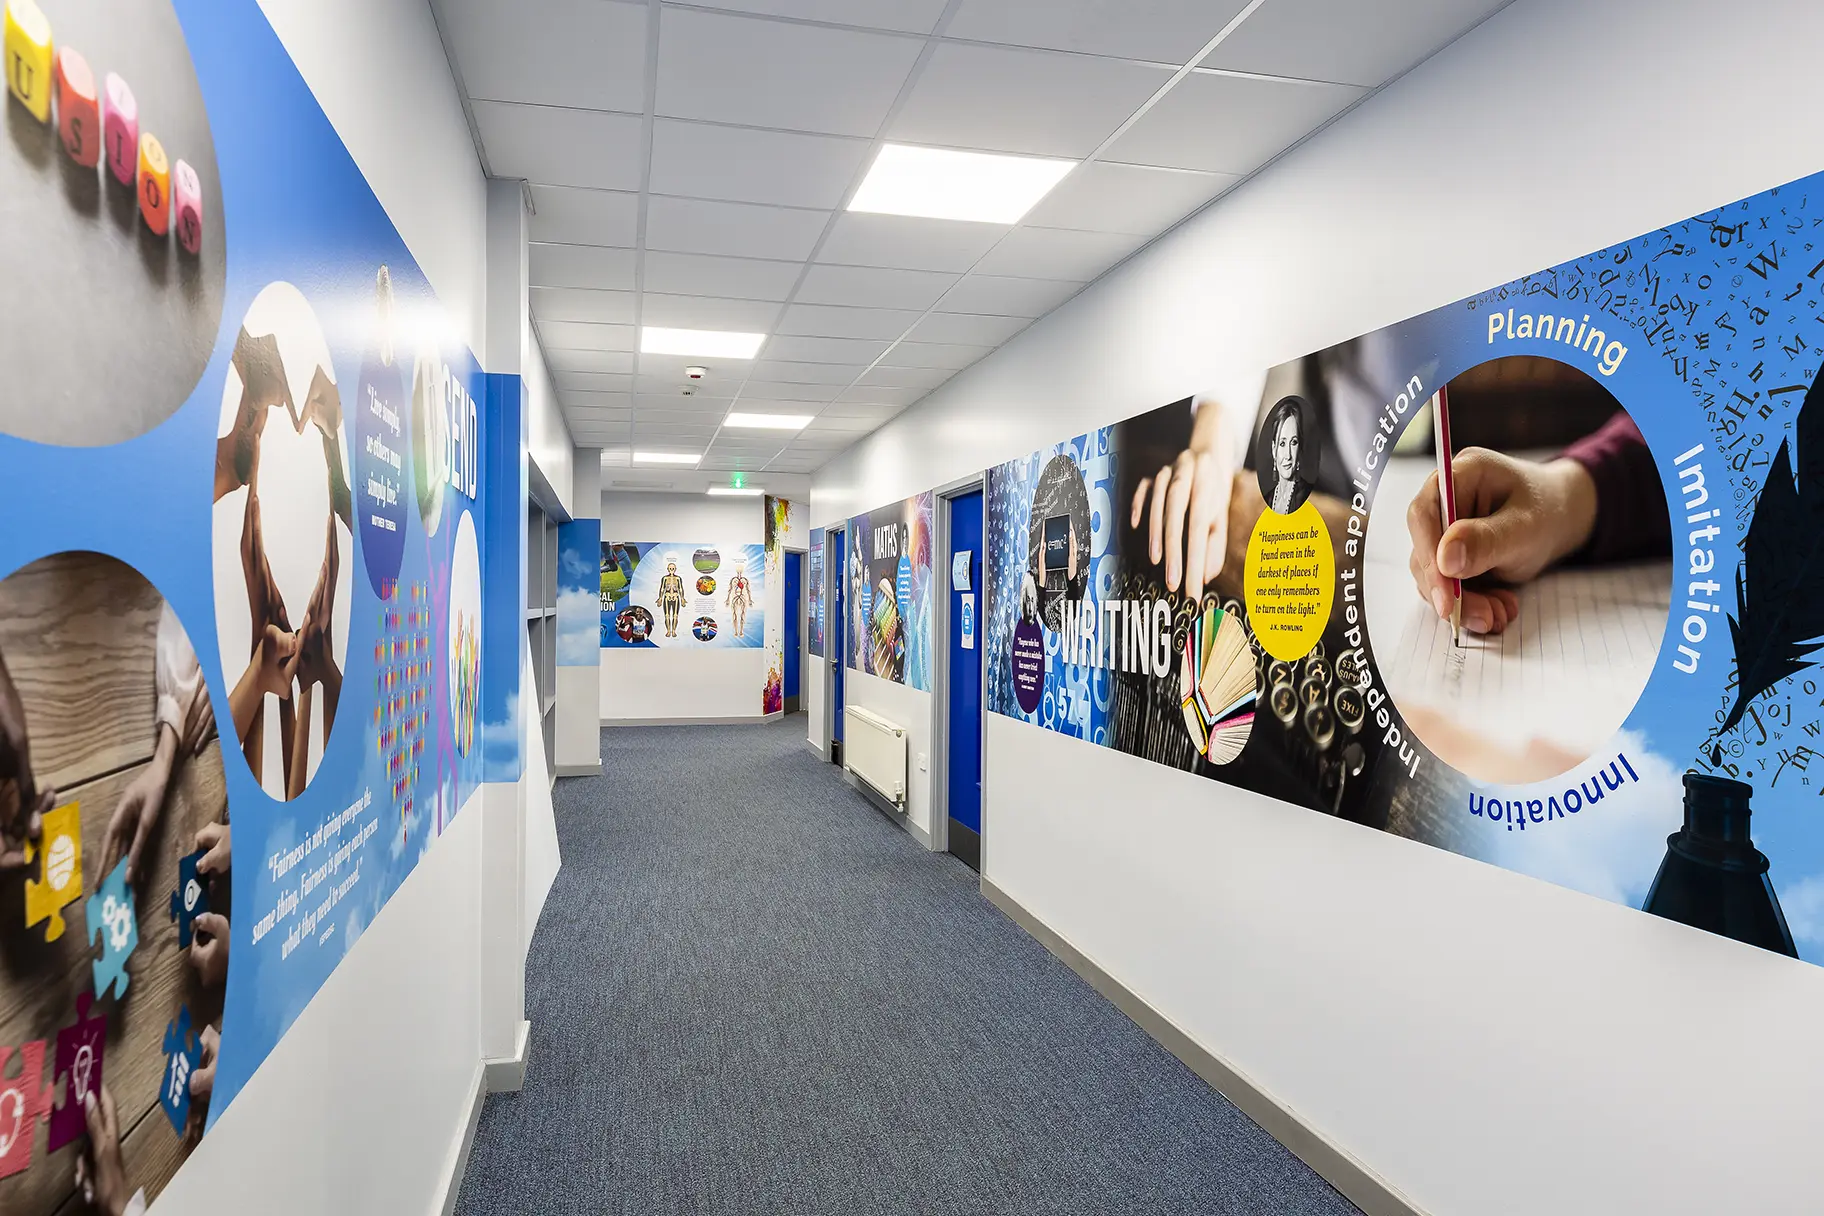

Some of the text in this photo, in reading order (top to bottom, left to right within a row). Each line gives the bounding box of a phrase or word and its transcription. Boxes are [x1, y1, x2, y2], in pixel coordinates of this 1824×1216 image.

[1488, 308, 1628, 376] Planning
[441, 363, 477, 500] SEND
[874, 522, 897, 560] MATHS
[1260, 545, 1315, 562] found even in the
[1296, 531, 1308, 540] can
[1310, 526, 1319, 538] be
[1673, 443, 1721, 674] Imitation
[1255, 583, 1320, 599] one only remembers
[1258, 564, 1319, 580] darkest of places if
[1341, 375, 1423, 778] Independent application
[1061, 599, 1172, 678] WRITING
[1255, 603, 1262, 614] to
[1262, 604, 1276, 614] turn
[1277, 605, 1285, 614] on
[1286, 602, 1297, 615] the
[1281, 624, 1304, 632] ROWLING
[305, 832, 312, 854] is
[312, 824, 323, 849] not
[324, 812, 341, 847] giving
[342, 798, 363, 826] everyone
[363, 786, 371, 806] the
[1469, 752, 1639, 831] Innovation
[252, 817, 378, 945] same thing. Fairness is giving each person
[281, 922, 300, 960] what
[301, 910, 316, 939] they
[317, 887, 331, 923] need
[332, 891, 338, 907] to
